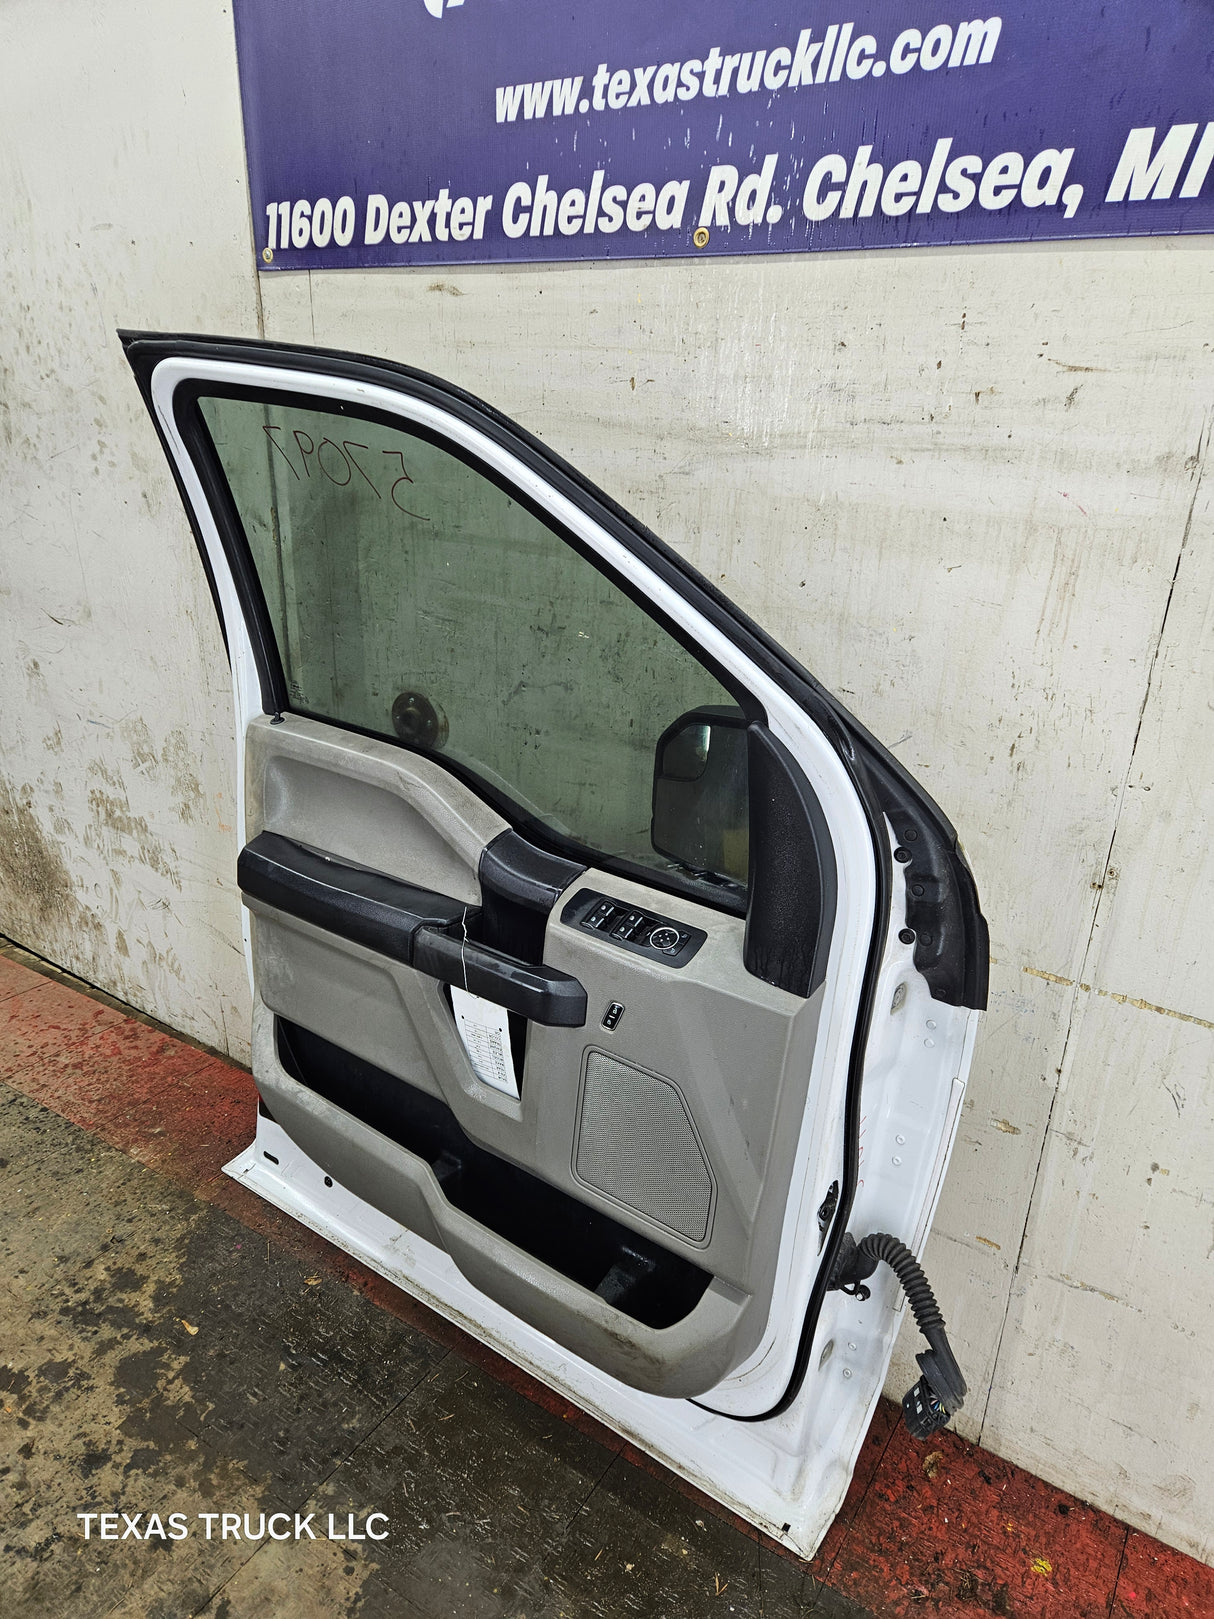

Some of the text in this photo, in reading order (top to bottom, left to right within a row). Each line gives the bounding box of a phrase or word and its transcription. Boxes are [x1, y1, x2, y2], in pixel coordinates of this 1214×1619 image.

[495, 15, 1003, 124] www.texastruckllc.com
[264, 121, 1214, 250] 11600 Dexter Chelsea Rd. Chelsea, MI
